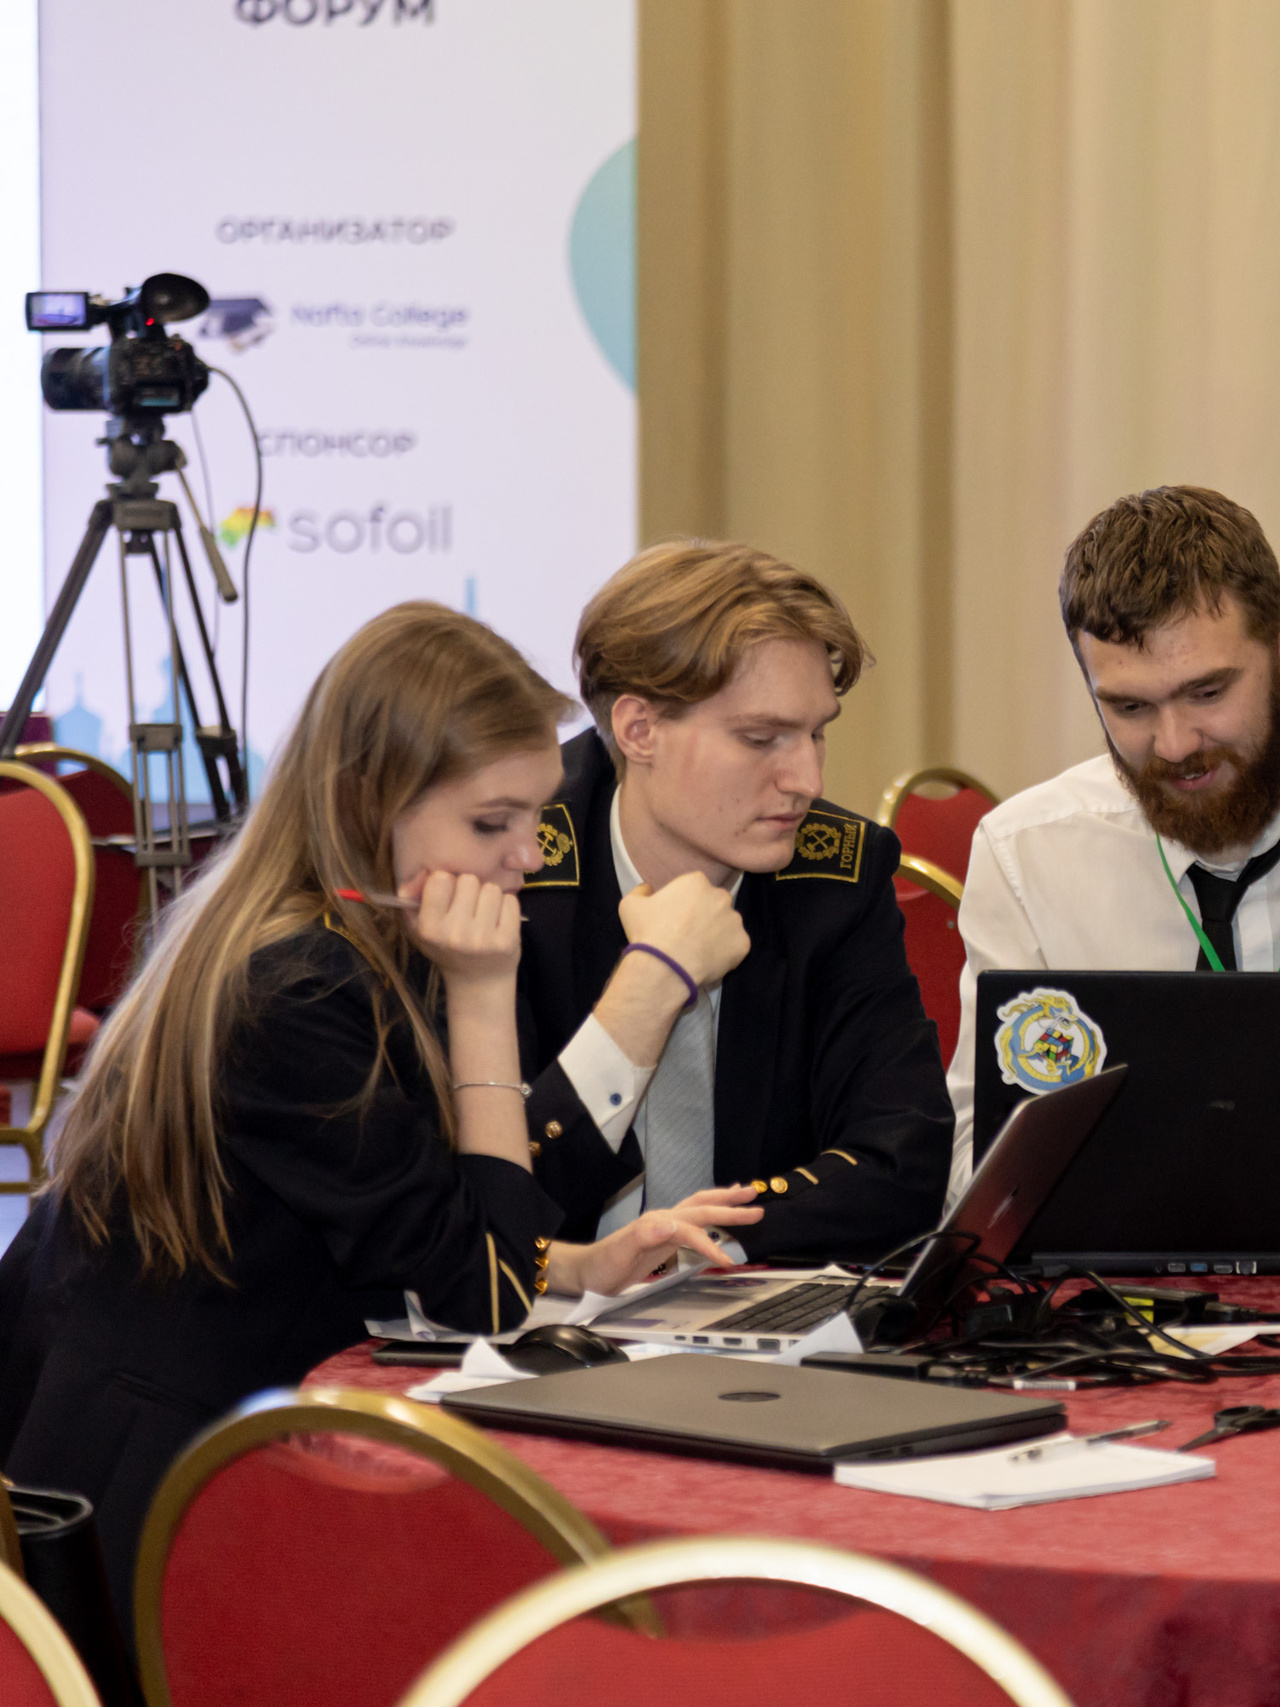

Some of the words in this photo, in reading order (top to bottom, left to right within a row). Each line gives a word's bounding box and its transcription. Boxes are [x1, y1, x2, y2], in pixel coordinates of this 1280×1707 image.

[235, 0, 434, 26] ФОРУМ
[216, 217, 454, 244] ОРГАНИЗАТОР
[257, 430, 417, 458] СПОНСОР
[287, 501, 453, 554] sofoil
[840, 823, 858, 869] ГОРНЫЙ
